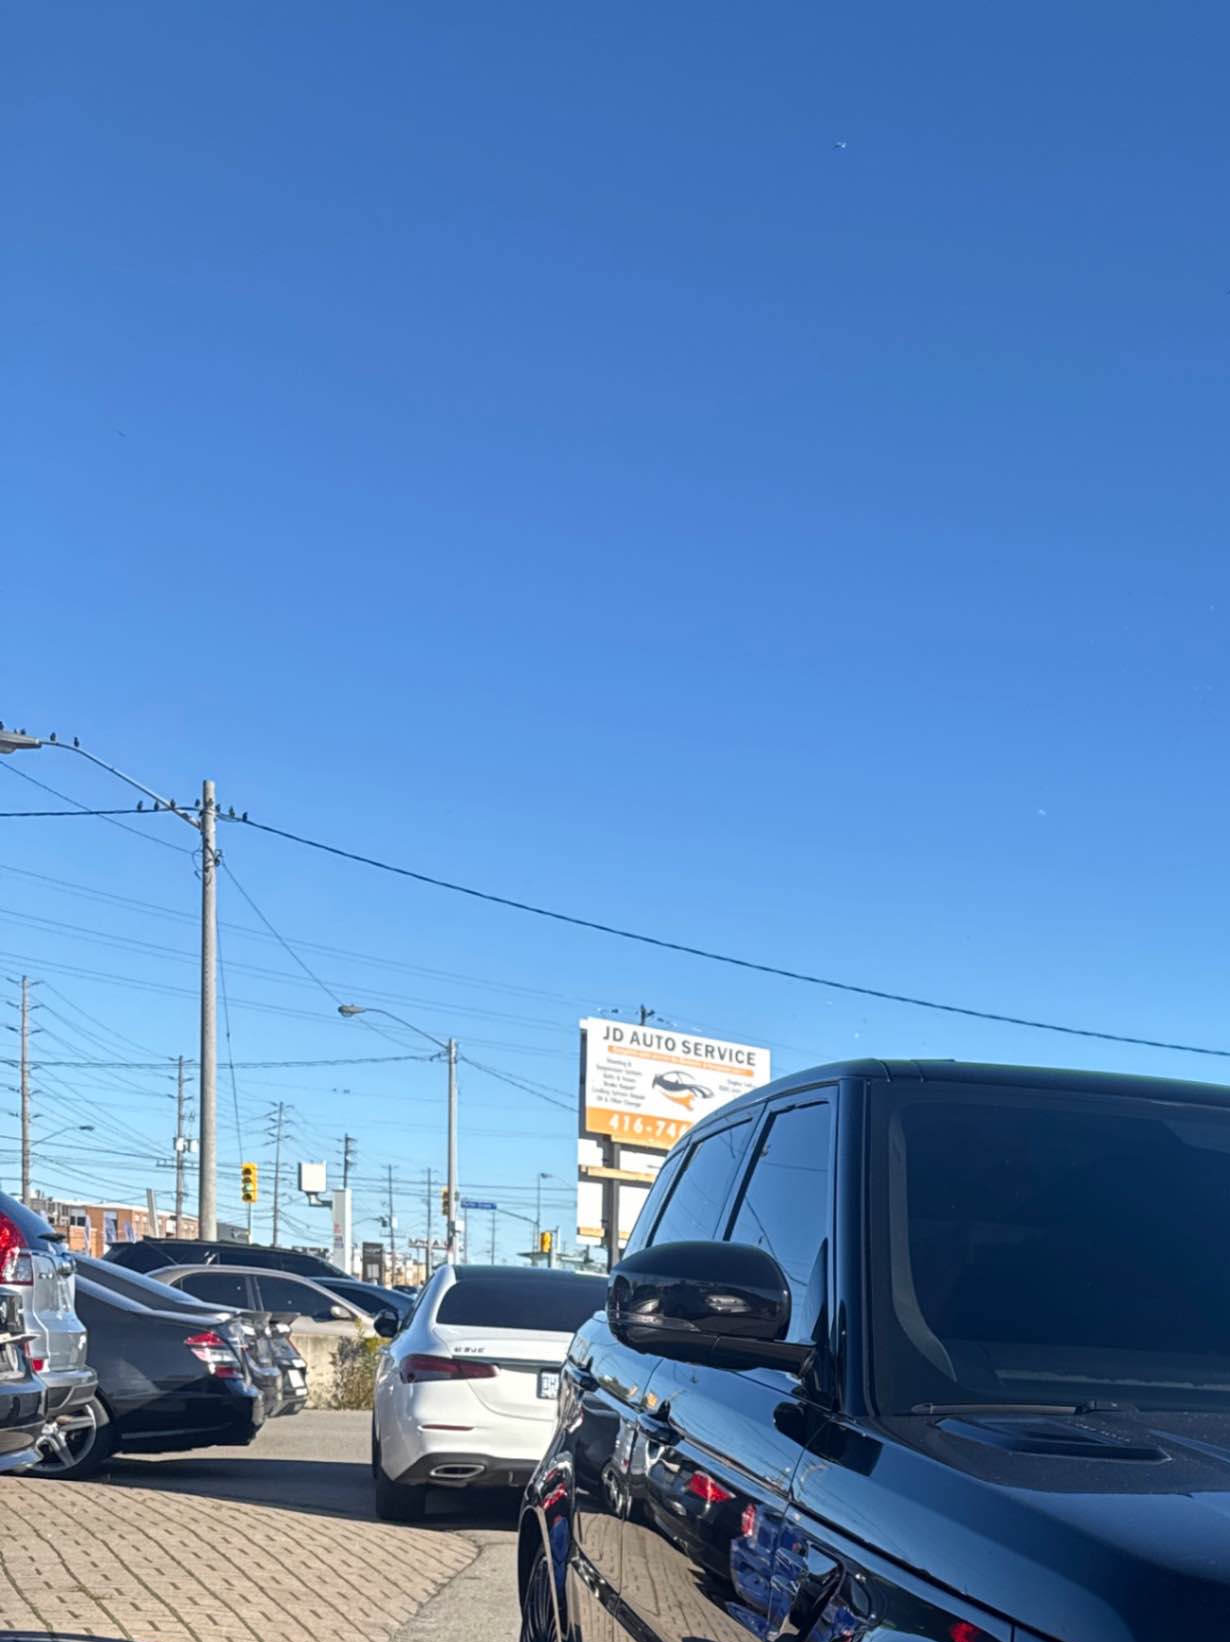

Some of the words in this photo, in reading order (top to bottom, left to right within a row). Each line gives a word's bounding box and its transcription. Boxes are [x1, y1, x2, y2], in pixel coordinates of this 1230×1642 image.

[603, 1026, 624, 1042] JD
[630, 1031, 676, 1052] AUTO
[681, 1040, 756, 1067] SERVICE
